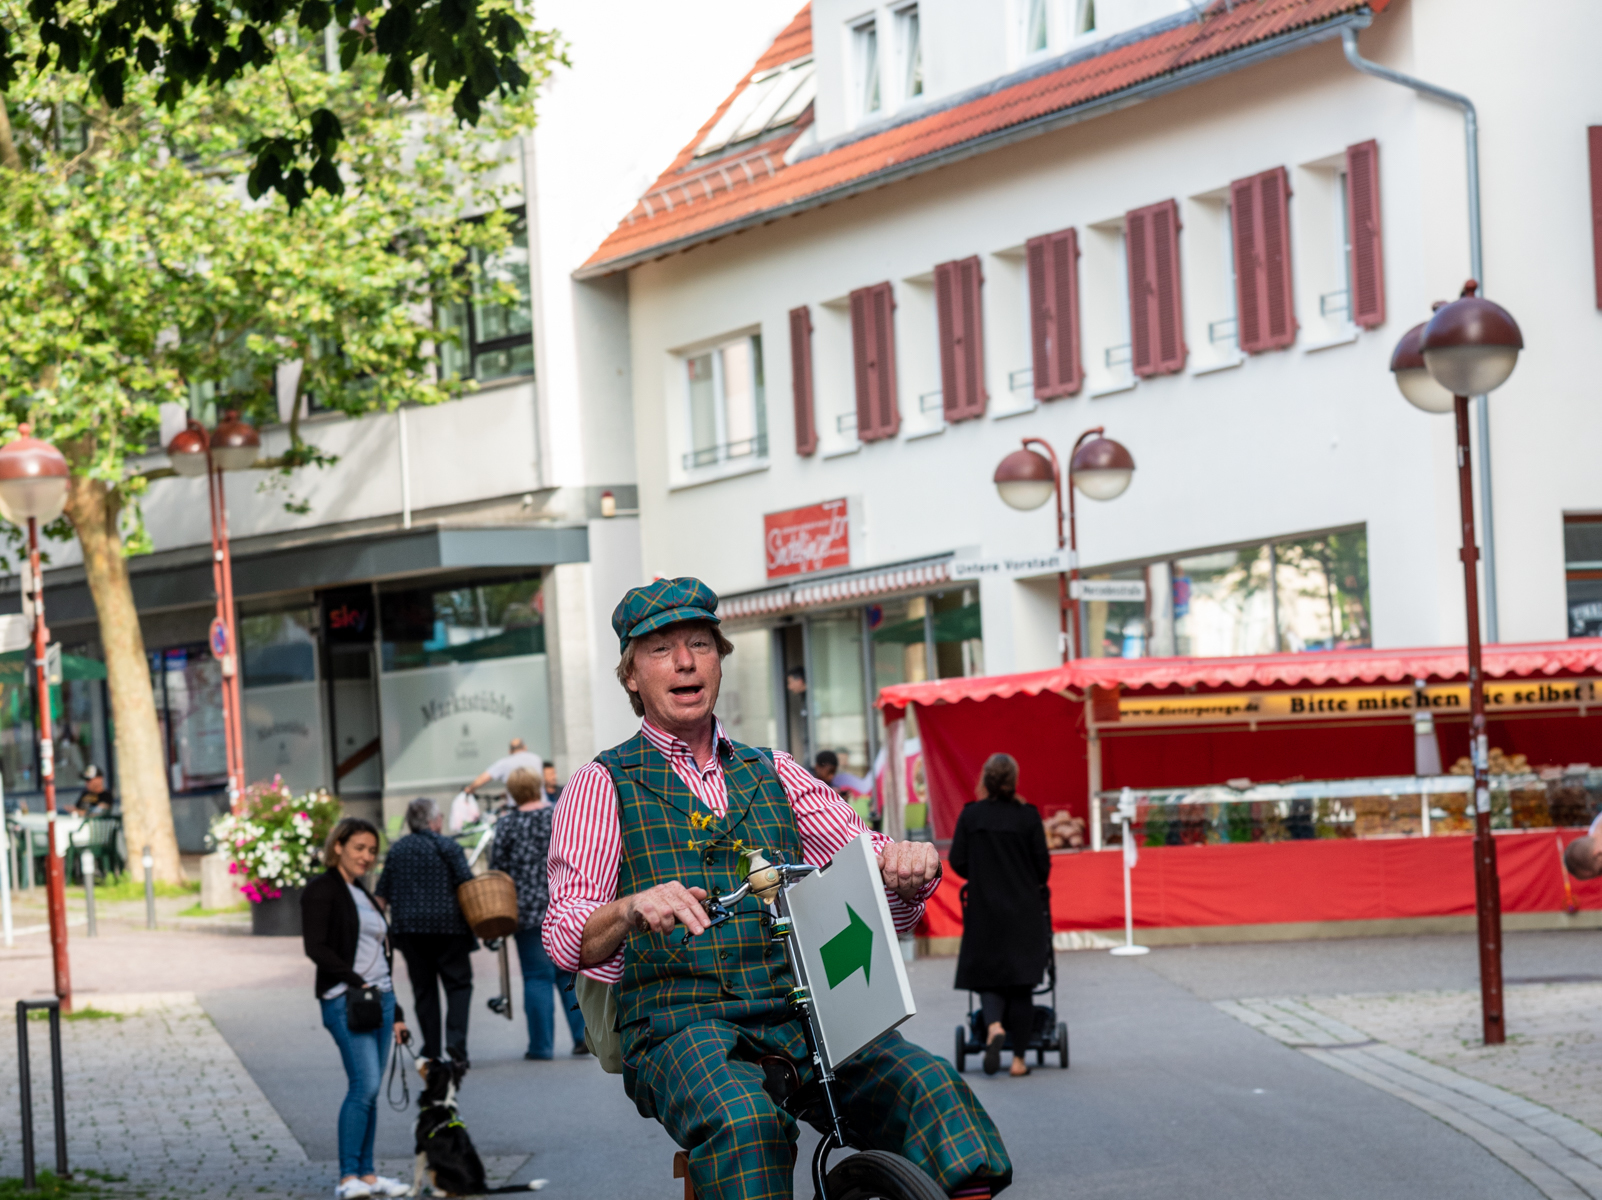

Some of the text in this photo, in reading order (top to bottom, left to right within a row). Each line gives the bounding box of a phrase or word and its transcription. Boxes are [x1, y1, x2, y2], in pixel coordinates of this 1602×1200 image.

[956, 556, 1060, 575] Untere Vorstadt
[1290, 694, 1348, 714] Bitte
[1357, 690, 1461, 711] mischen
